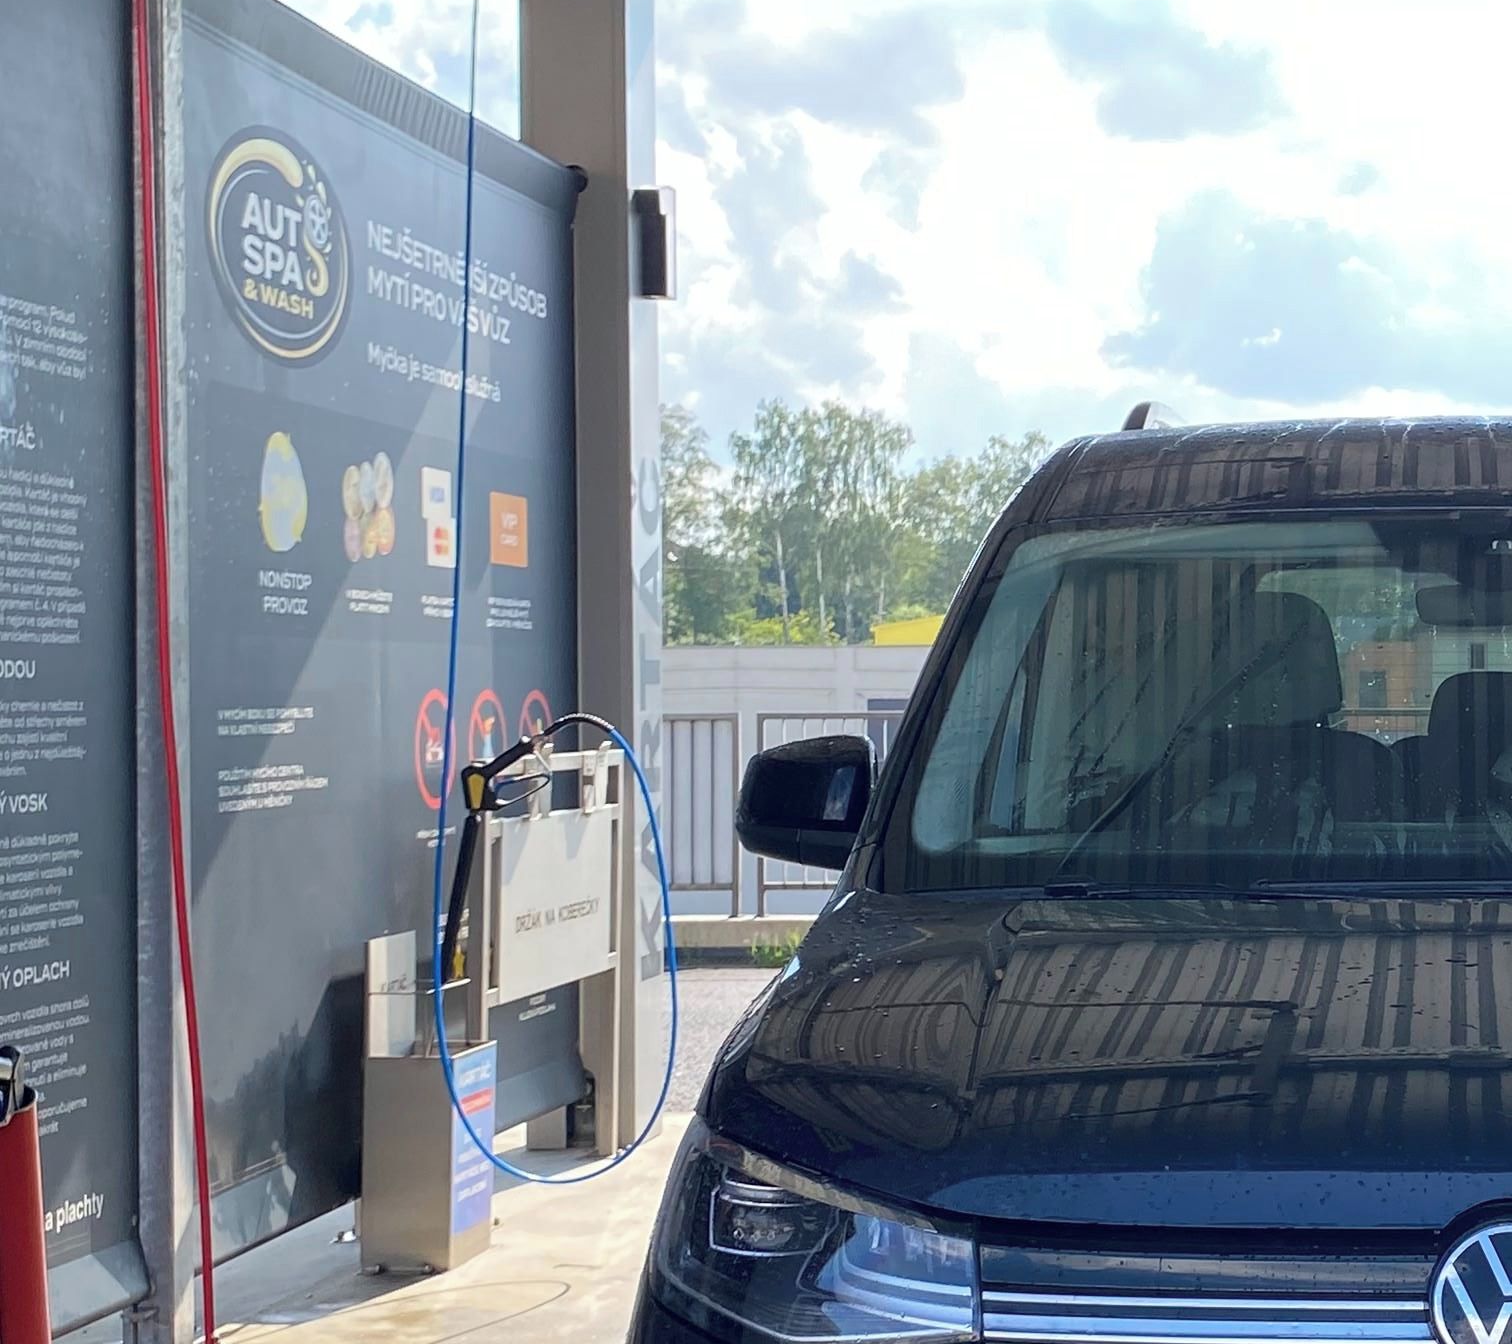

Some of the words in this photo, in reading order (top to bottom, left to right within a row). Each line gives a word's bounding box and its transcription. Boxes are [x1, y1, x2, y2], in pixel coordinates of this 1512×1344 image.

[243, 233, 304, 291] SPA
[244, 278, 258, 301] &
[262, 283, 315, 320] WASH
[368, 266, 411, 308] MYTÍ
[411, 284, 447, 322] PRO
[480, 305, 511, 345] VŮZ
[489, 272, 548, 319] ZPŮSOB
[368, 342, 408, 374] Myčka
[408, 354, 421, 382] je
[0, 420, 36, 450] RTÁČ
[259, 570, 312, 591] NONSTOP
[263, 596, 308, 616] PROVOZ
[9, 792, 48, 814] VOSK
[545, 913, 555, 927] NA
[13, 960, 70, 988] OPLACH
[56, 1192, 104, 1234] plachty
